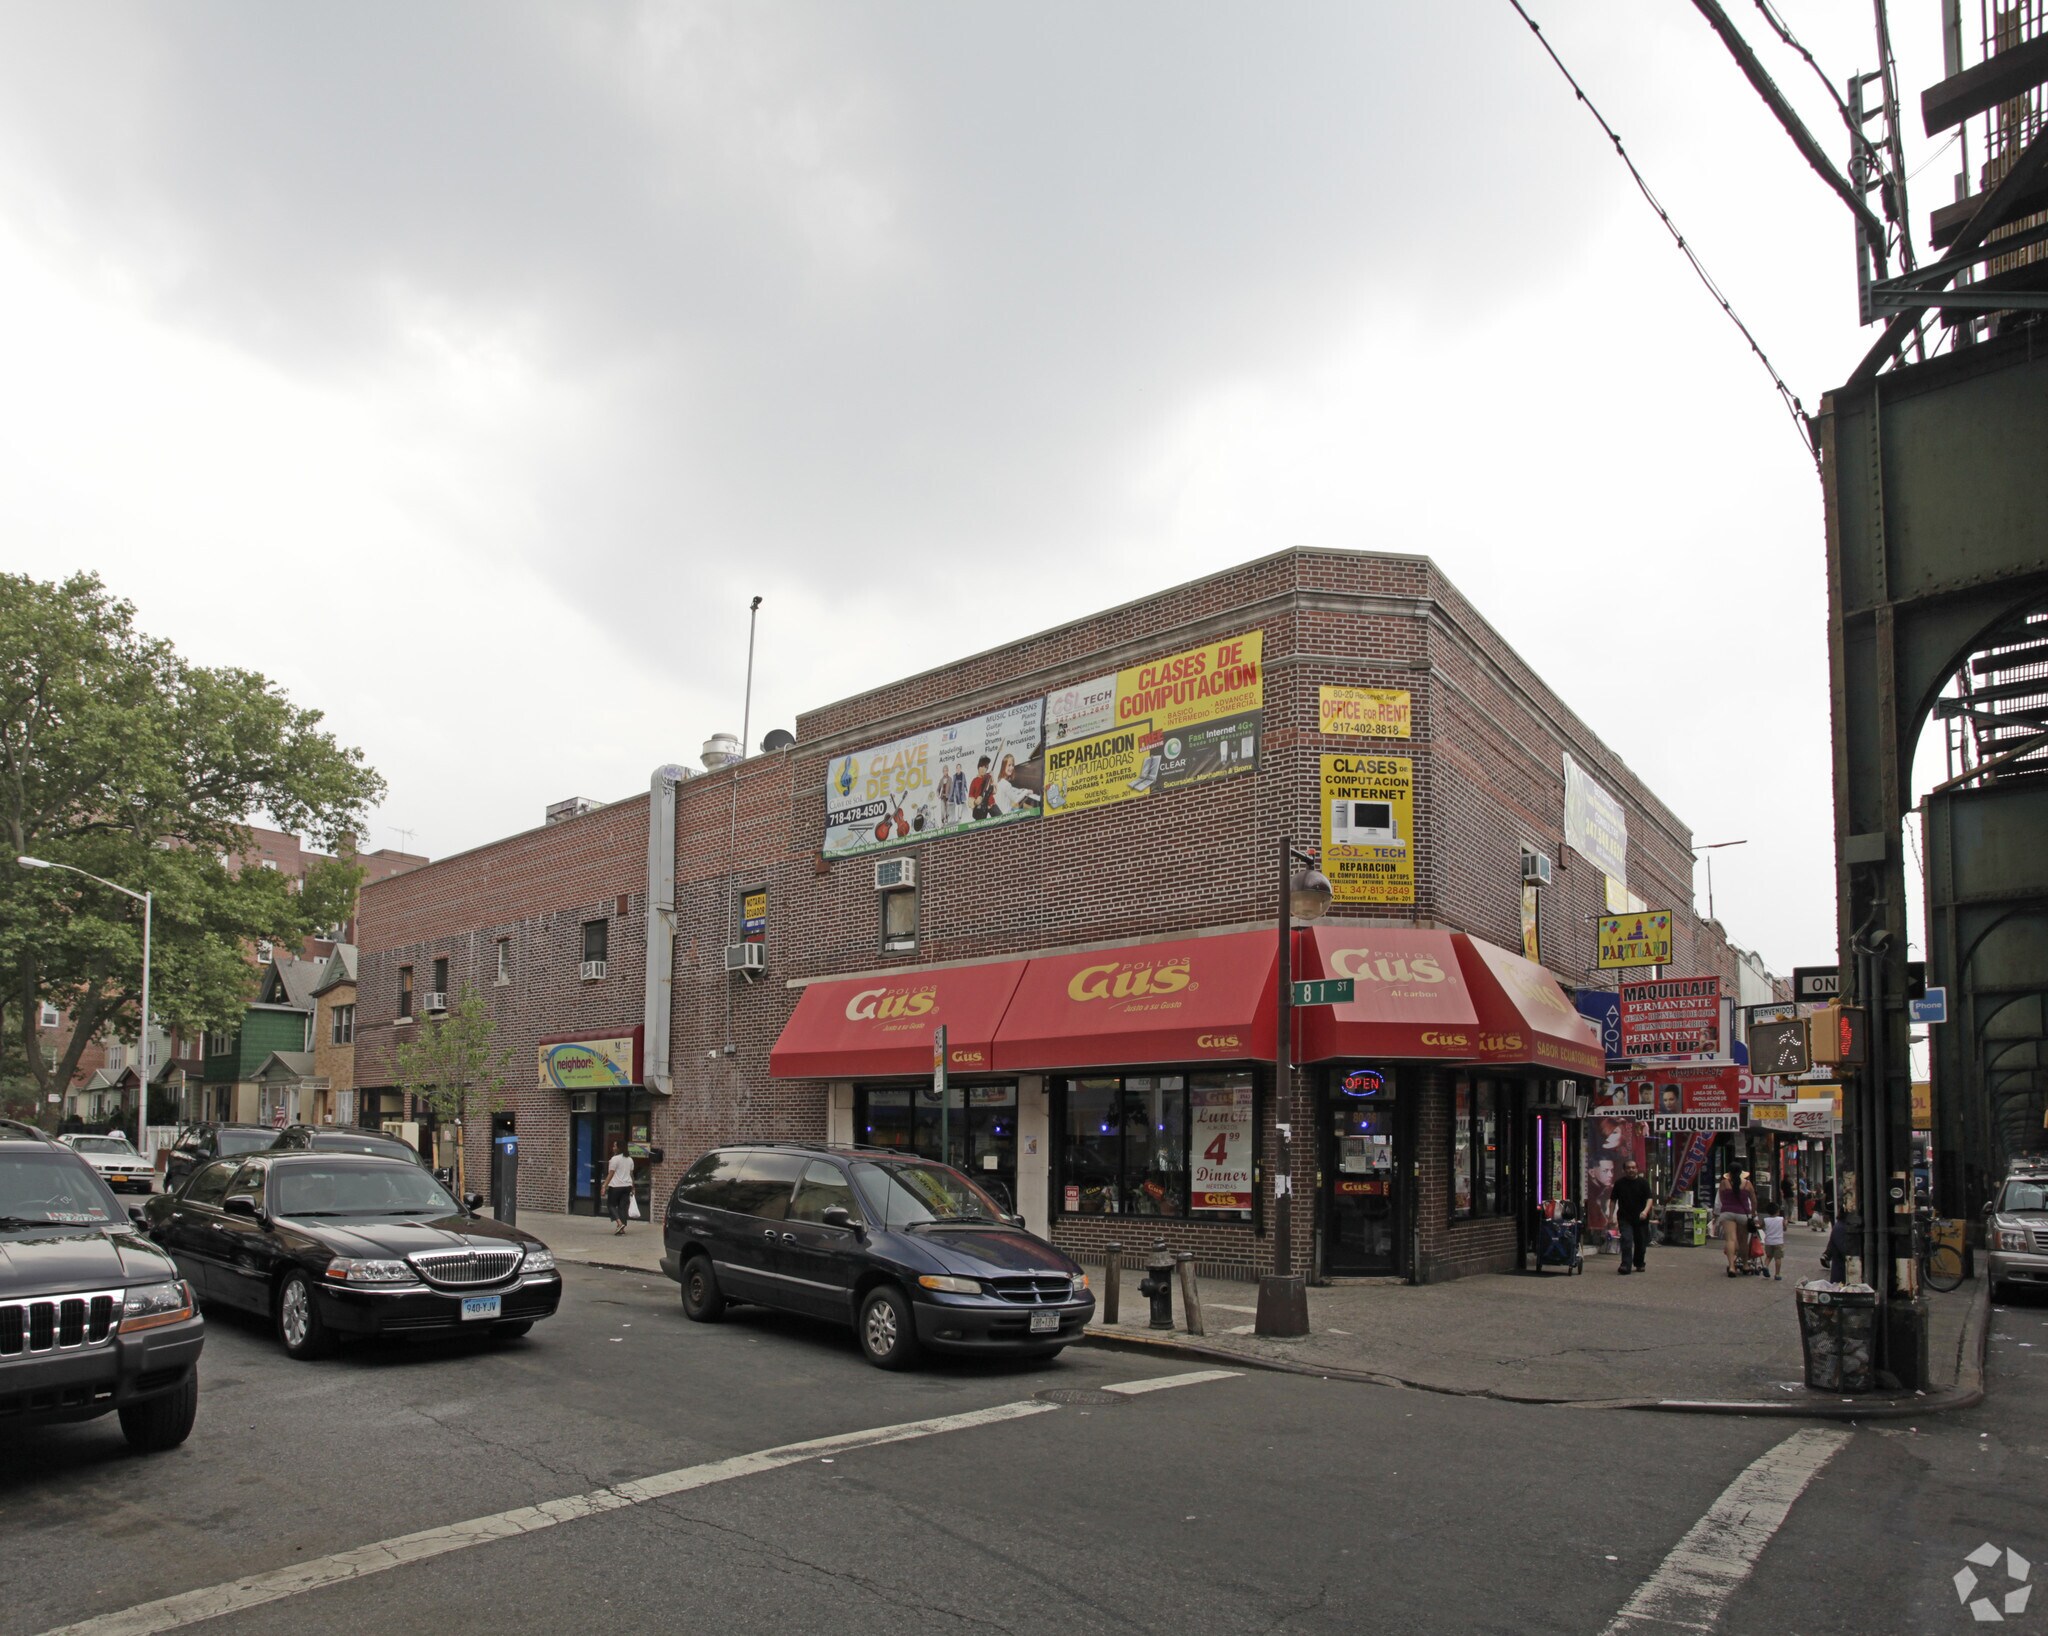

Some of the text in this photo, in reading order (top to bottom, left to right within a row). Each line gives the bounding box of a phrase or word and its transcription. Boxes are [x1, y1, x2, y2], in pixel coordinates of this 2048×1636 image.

[1138, 641, 1243, 690] CLASES DE
[1119, 662, 1257, 719] COMPUTACION
[1333, 689, 1353, 699] 80-20
[1083, 690, 1112, 706] TECH
[986, 702, 1038, 724] MUSIC LESSONS
[1167, 707, 1193, 719] BASICO
[1214, 699, 1258, 714] COMERCIAL
[1322, 699, 1408, 722] OFFICE FOR RENT
[1021, 712, 1037, 721] Piano
[1167, 711, 1210, 726] INTERMEDIO
[985, 729, 1000, 738] Vocal
[986, 722, 1003, 731] Guitar
[1019, 726, 1036, 736] Violin
[1188, 721, 1254, 743] Fast Internet 4G+
[1332, 722, 1399, 735] 917-402-8818
[984, 736, 1002, 746] Drums
[1006, 734, 1036, 747] Percussion
[1026, 741, 1036, 750] Etc
[938, 748, 975, 764] Acting Classes
[939, 745, 962, 756] Modeling
[984, 745, 999, 754] Flute
[1050, 733, 1135, 771] REPARACION
[870, 743, 929, 777] CLAVE
[1048, 751, 1134, 782] DE COMPUTADORAS
[1159, 760, 1187, 771] CLEAR
[1333, 758, 1398, 775] CLASES
[866, 765, 933, 801] DE SOL
[1066, 772, 1137, 792] PROGRAMS ANTIVIRUS
[1071, 774, 1098, 786] LAPTOPS
[1105, 767, 1132, 778] TABLETS
[1325, 775, 1409, 787] COMPUTACION
[1337, 788, 1406, 800] INTERNET
[829, 803, 884, 826] 718-478-4500
[1373, 847, 1406, 859] TECH
[1339, 862, 1396, 873] REPARACION
[1337, 872, 1379, 880] COMPUTADORAS
[1387, 873, 1409, 881] LAPTOPS
[1341, 894, 1366, 902] Roosevelt
[1374, 951, 1434, 960] POLLOS
[1602, 941, 1668, 961] PARTYLAND
[1122, 957, 1191, 971] POLLOS
[1330, 948, 1446, 983] Gus
[1067, 962, 1190, 1002] Gus
[1812, 977, 1837, 992] ON
[888, 984, 937, 996] POLLOS
[1304, 981, 1347, 1003] 81 ST
[1403, 990, 1438, 998] carbon
[1623, 980, 1717, 1003] MAQUILLAJE
[845, 987, 935, 1021] Gus
[1124, 1003, 1144, 1013] Justo
[1160, 1000, 1182, 1010] Gusto
[1628, 998, 1713, 1013] PERMANENTE
[1915, 1000, 1942, 1010] Phone
[1604, 1004, 1620, 1054] AVON
[1197, 1034, 1239, 1048] Gus
[1421, 1031, 1468, 1046] Gus
[1625, 1031, 1699, 1044] PERMANENT
[1537, 1041, 1559, 1059] SABOR
[1626, 1041, 1700, 1056] MAKE UP
[952, 1050, 983, 1063] Gus
[1345, 1077, 1379, 1090] OPEN
[1197, 1110, 1249, 1124] Lunch
[1655, 1115, 1738, 1132] PELUQUERIA
[507, 1143, 514, 1154] P
[1203, 1132, 1240, 1166] 4 99
[1377, 1149, 1388, 1162] A
[1196, 1168, 1248, 1182] Dinner
[1915, 1176, 1923, 1187] P
[1204, 1193, 1237, 1206] Gus
